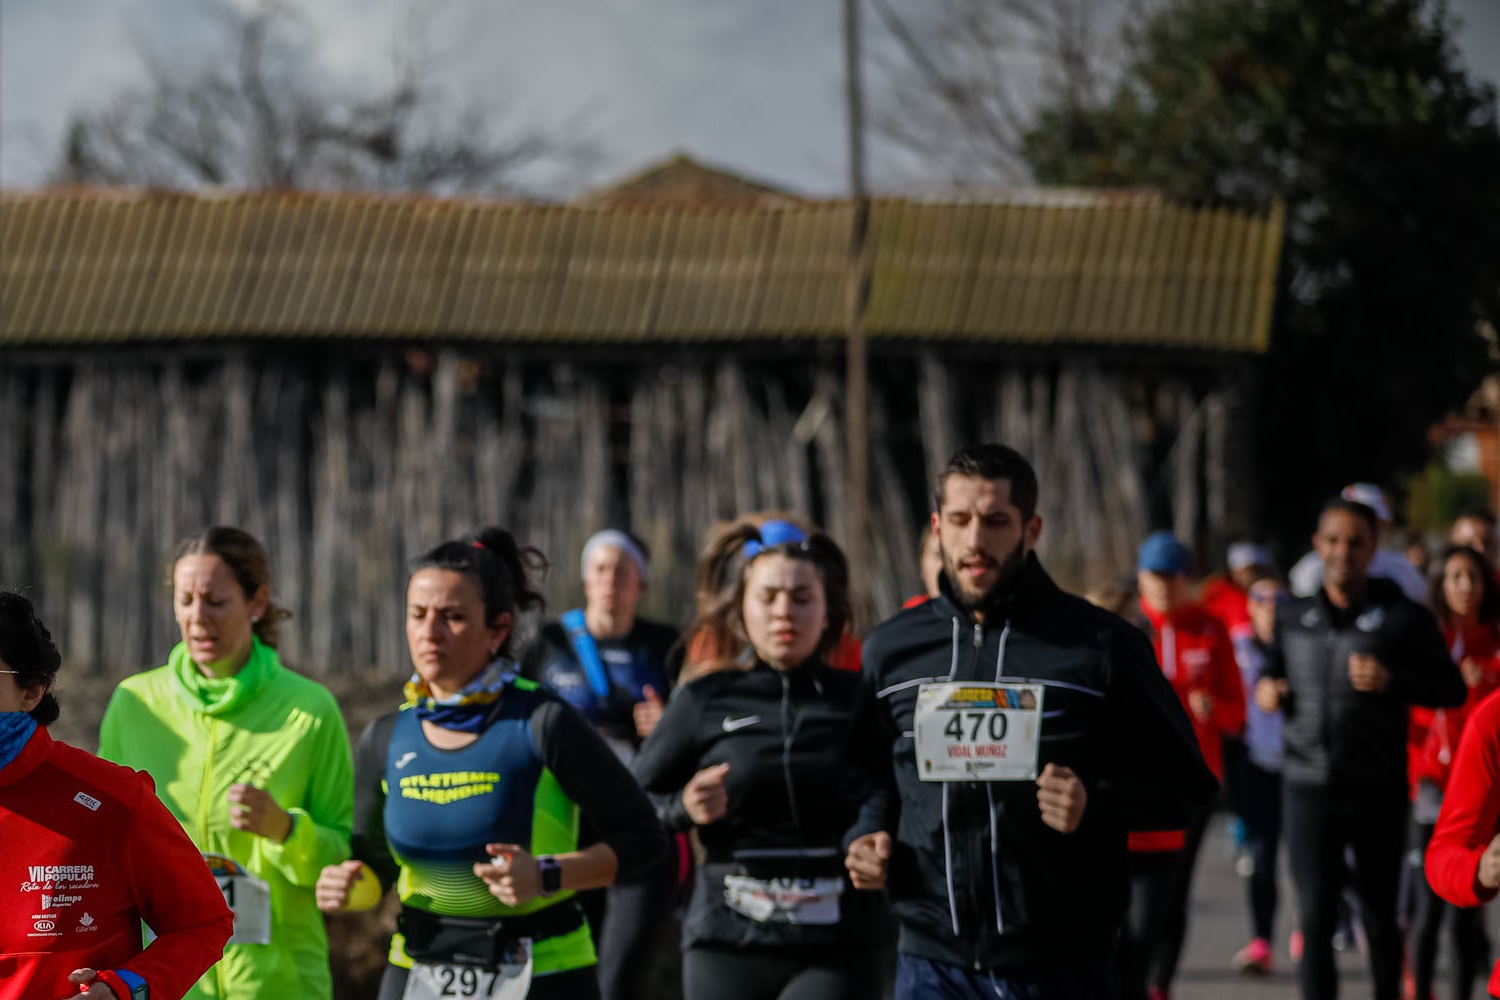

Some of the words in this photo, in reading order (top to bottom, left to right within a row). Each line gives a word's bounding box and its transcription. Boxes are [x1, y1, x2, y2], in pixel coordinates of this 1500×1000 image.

[944, 712, 1008, 741] 470
[28, 865, 45, 882] VII
[44, 865, 94, 874] CARRERA
[44, 873, 94, 882] POPULAR
[20, 881, 41, 892] Ruta
[43, 880, 53, 890] de
[52, 894, 82, 903] olimpo
[440, 966, 501, 997] 297
